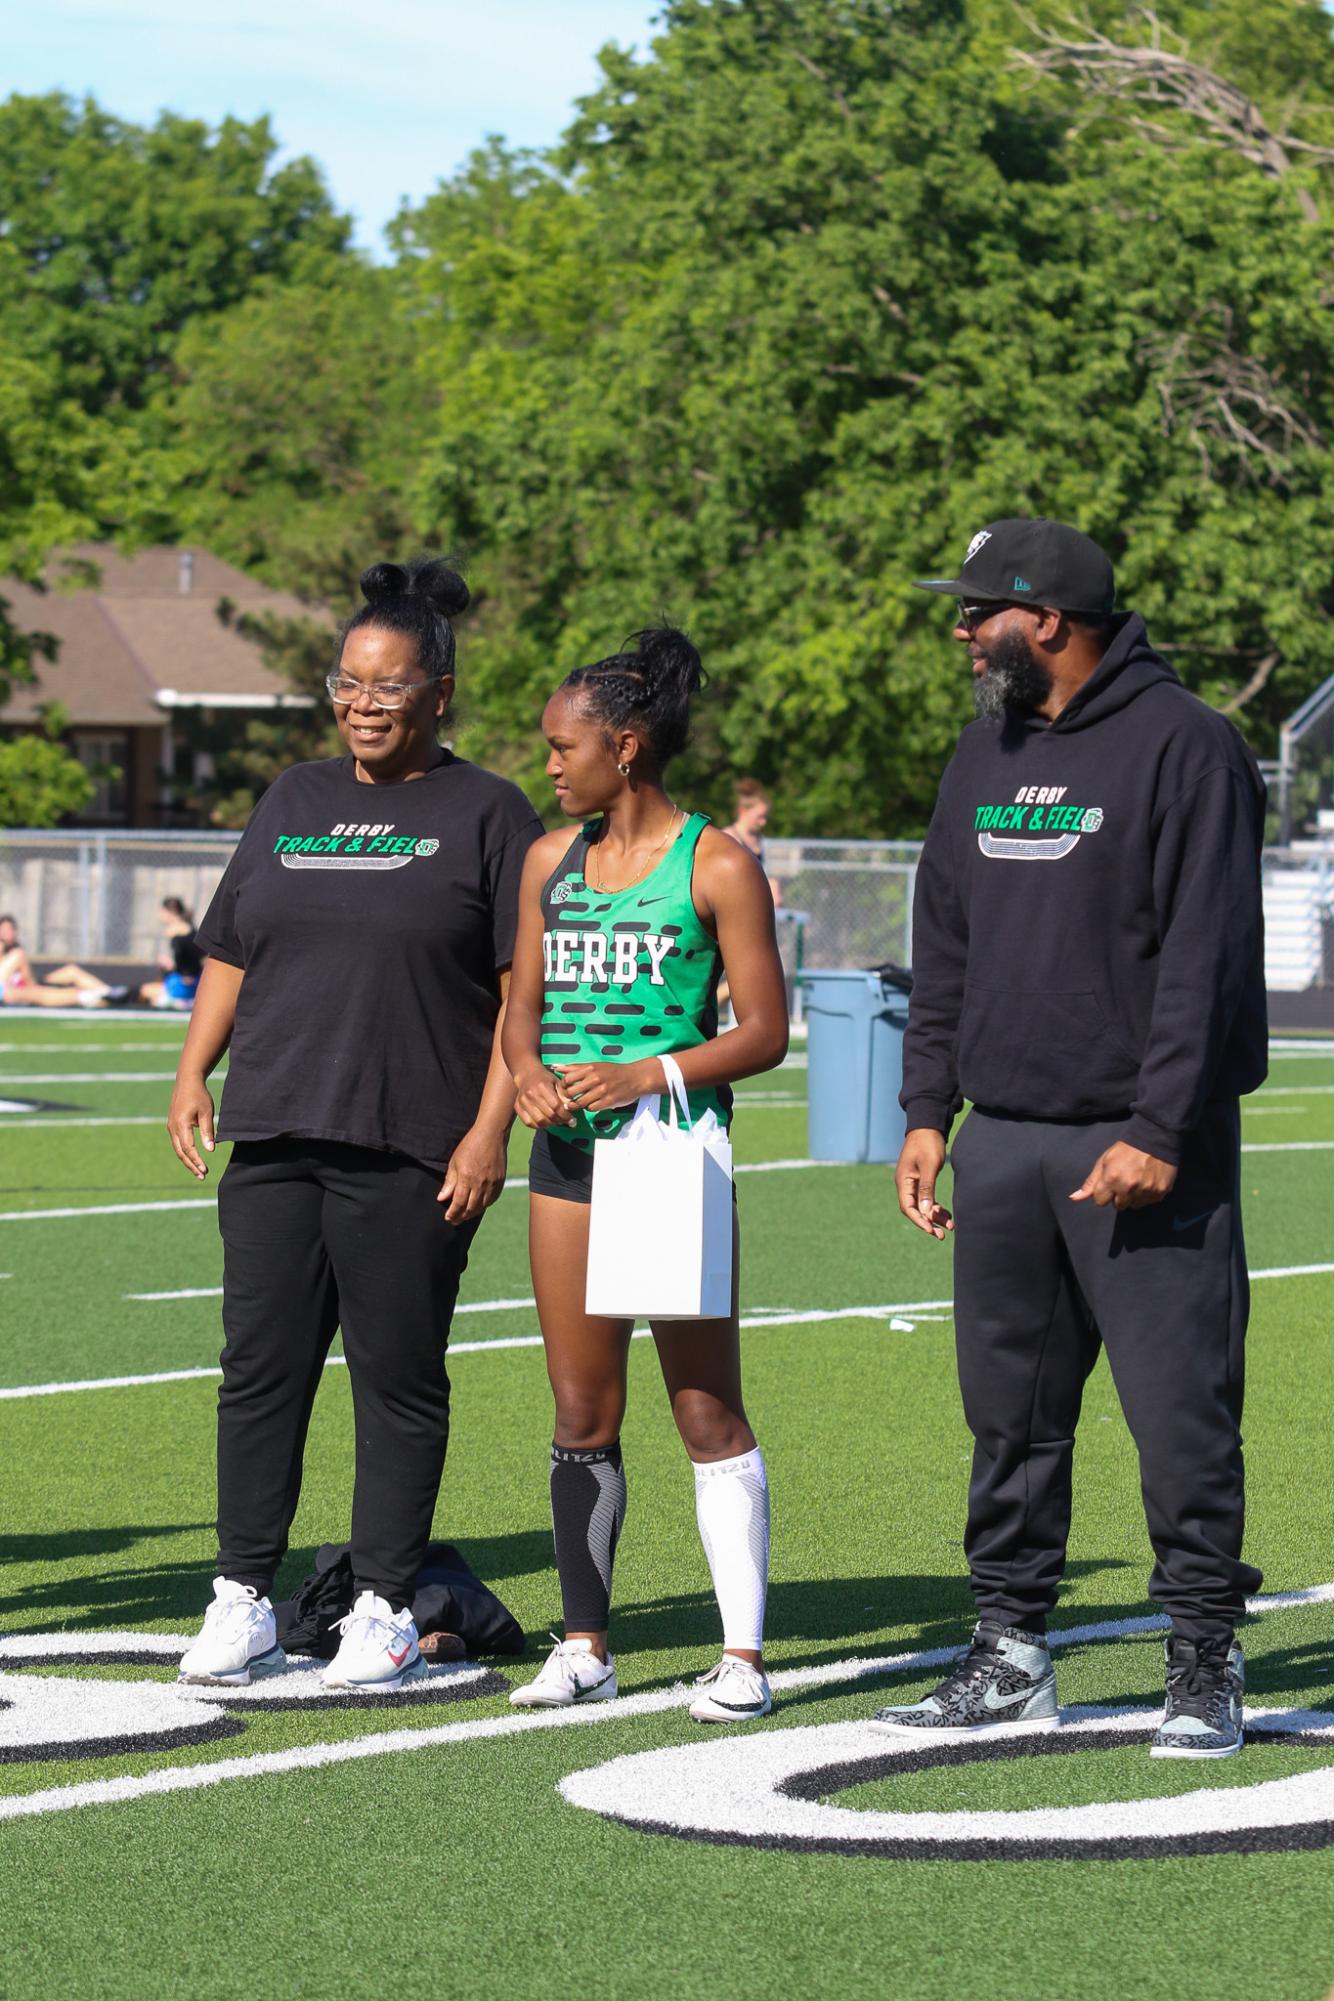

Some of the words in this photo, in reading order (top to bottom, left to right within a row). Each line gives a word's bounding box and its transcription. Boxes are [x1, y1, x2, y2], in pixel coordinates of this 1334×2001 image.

[1014, 786, 1068, 804] DERBY
[974, 805, 1029, 831] TRACK
[1028, 806, 1045, 831] &
[330, 823, 395, 837] DERBY
[273, 835, 346, 854] TRACK
[344, 836, 364, 853] &
